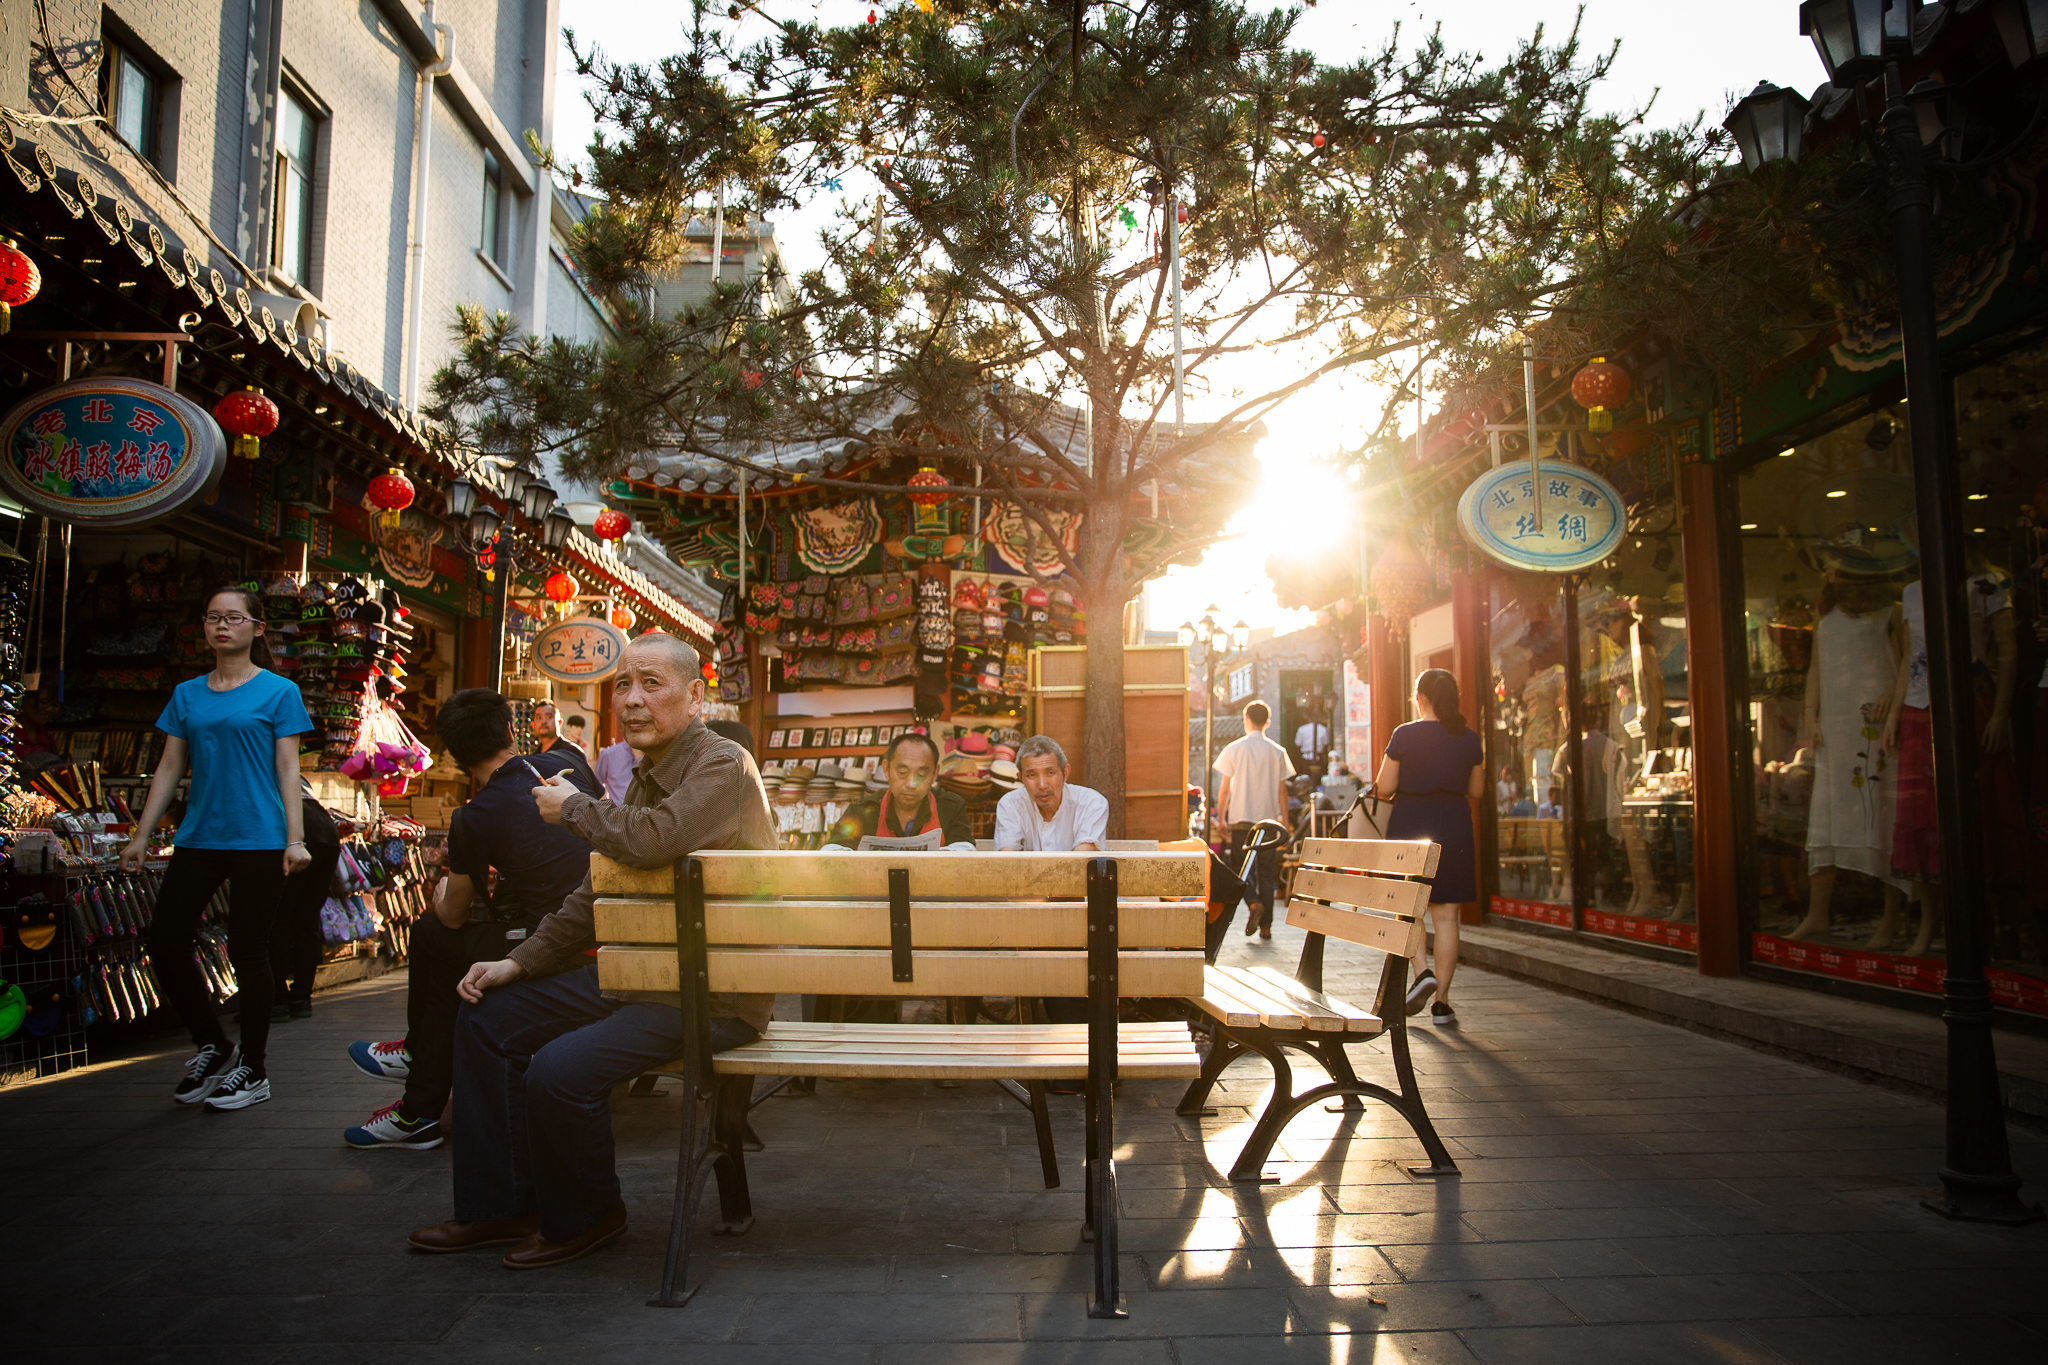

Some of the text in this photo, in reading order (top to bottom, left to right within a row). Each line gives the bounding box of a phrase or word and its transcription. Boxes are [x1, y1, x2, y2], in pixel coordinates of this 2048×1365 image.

[32, 398, 165, 437] 老北京
[24, 438, 174, 484] 冰镇酸梅汤
[1491, 479, 1603, 509] 北京故事
[1511, 512, 1587, 543] 丝绸
[302, 605, 325, 619] BOY
[545, 637, 611, 660] 卫生间
